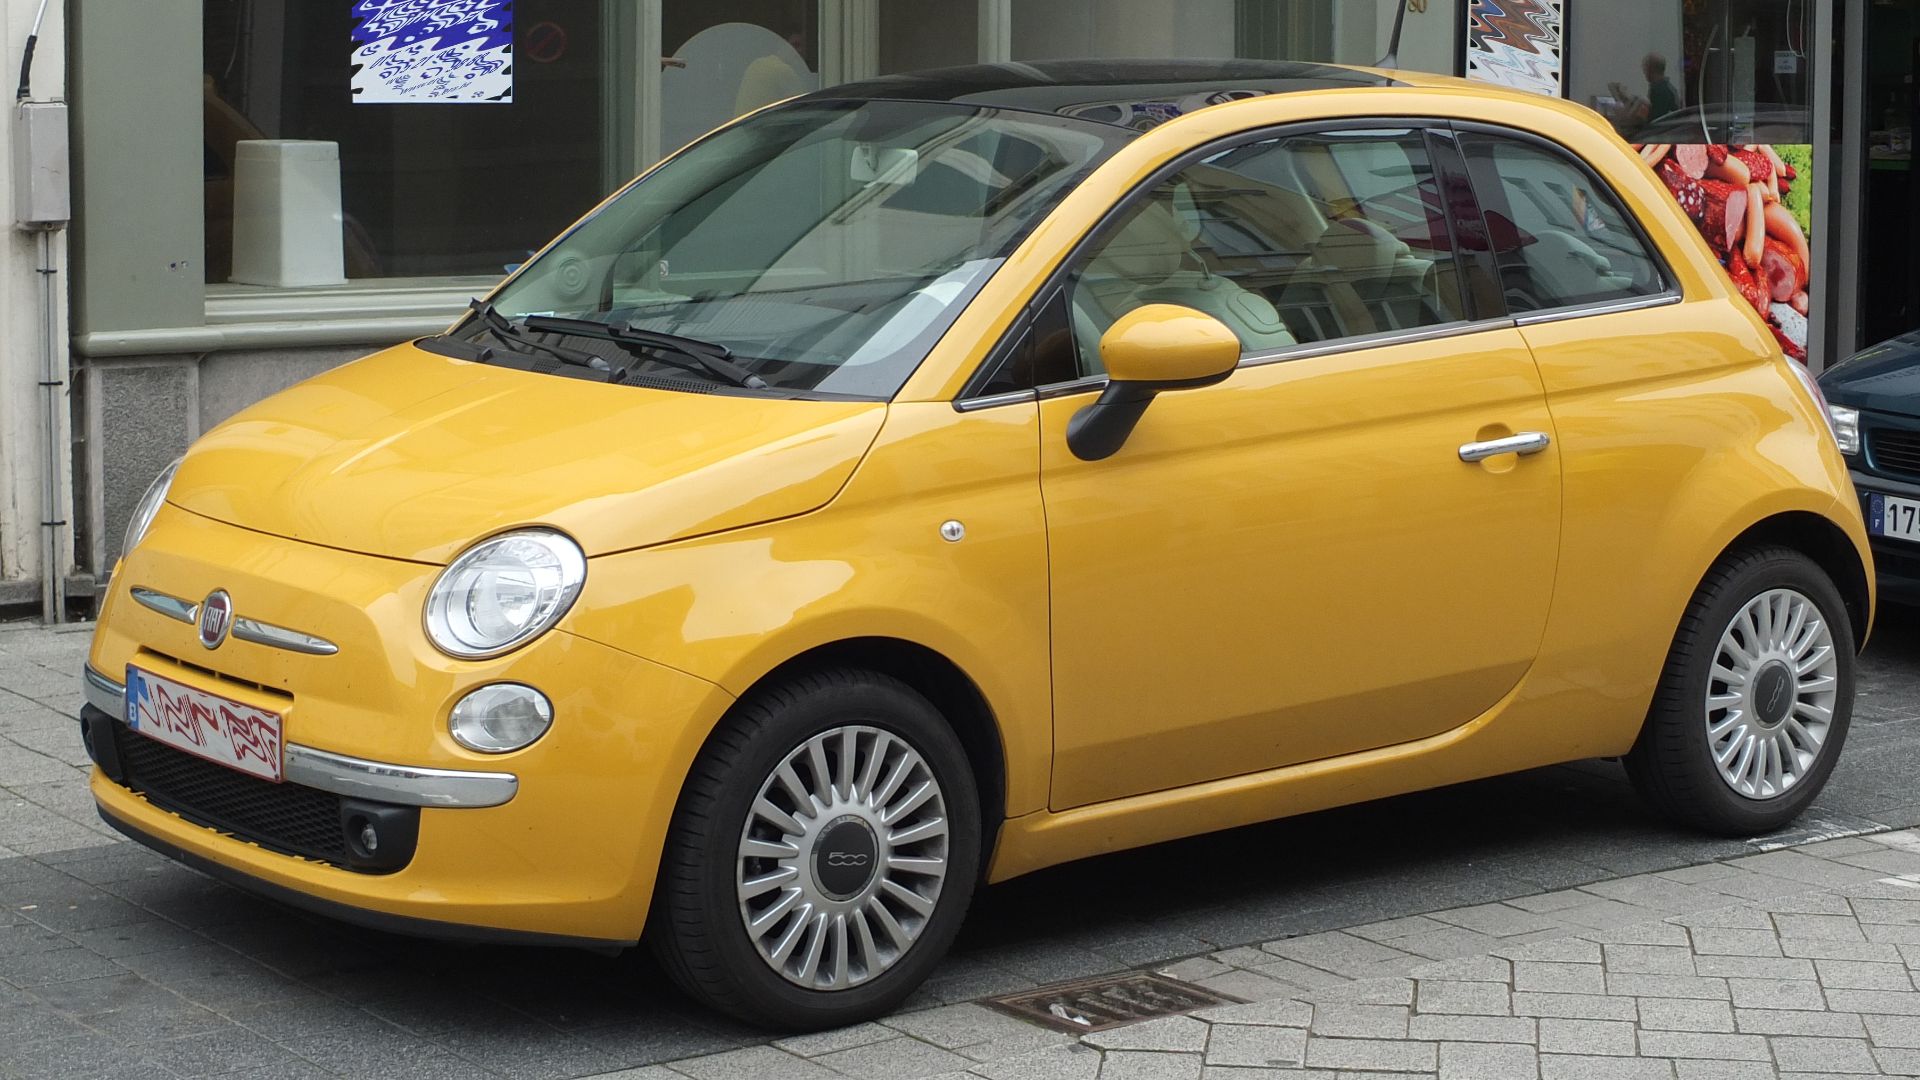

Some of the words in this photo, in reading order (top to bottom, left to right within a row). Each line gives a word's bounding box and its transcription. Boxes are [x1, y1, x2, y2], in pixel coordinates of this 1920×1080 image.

[1874, 518, 1880, 528] F
[1888, 503, 1920, 534] 17
[203, 606, 225, 634] FIAT
[128, 702, 137, 722] B
[827, 851, 868, 866] 500
